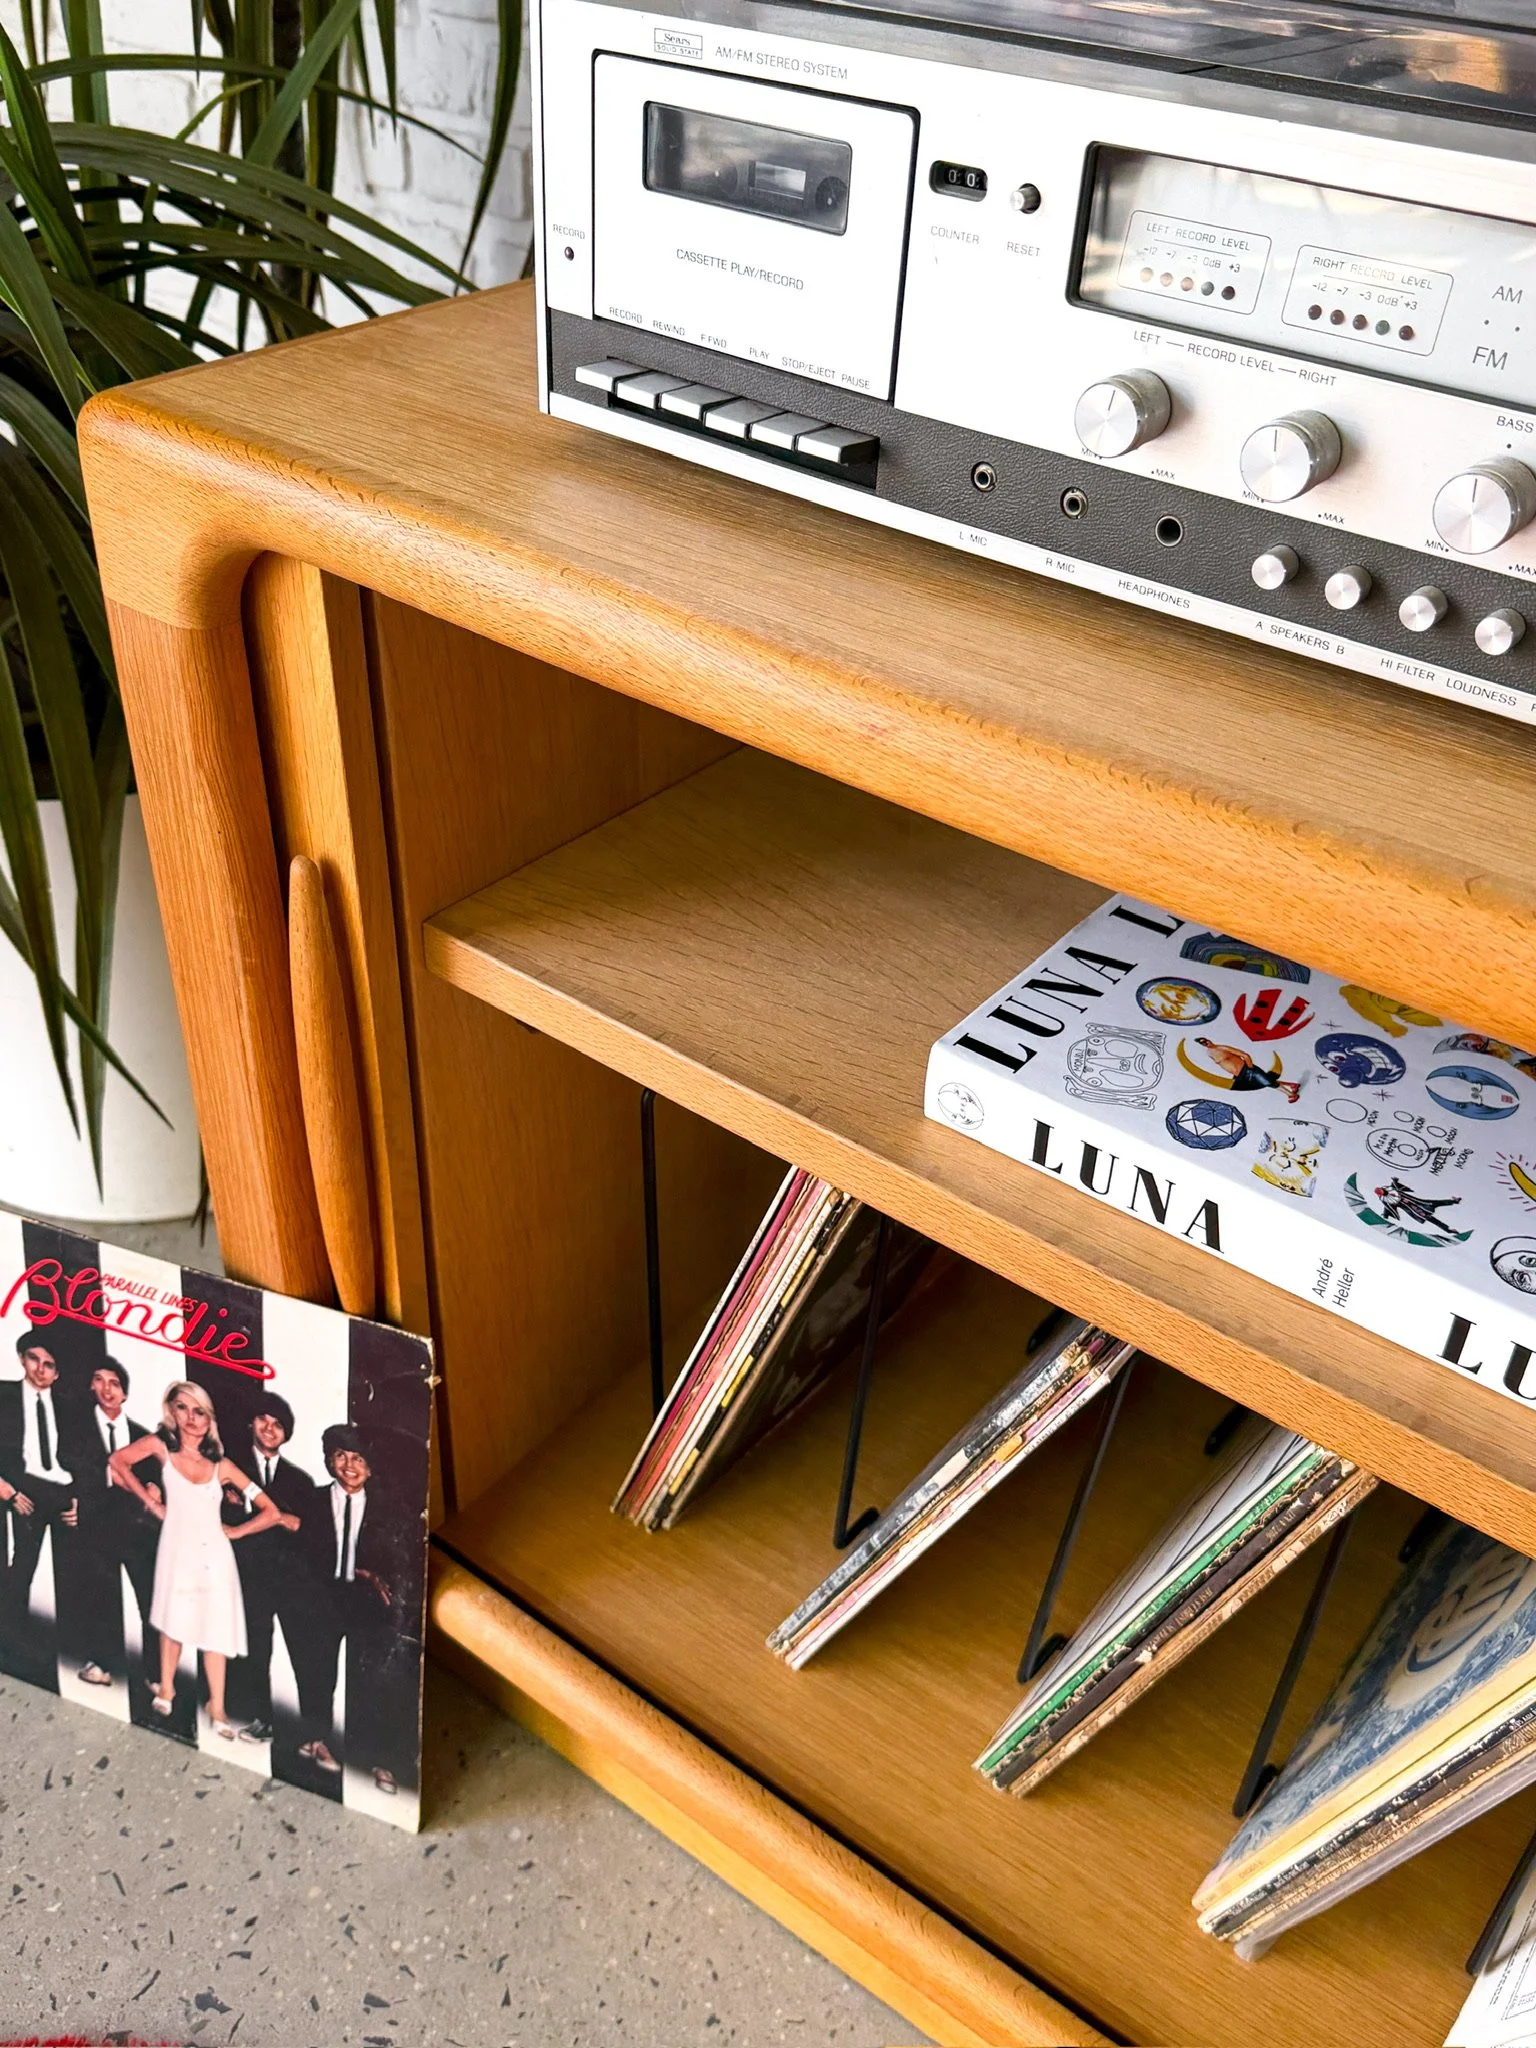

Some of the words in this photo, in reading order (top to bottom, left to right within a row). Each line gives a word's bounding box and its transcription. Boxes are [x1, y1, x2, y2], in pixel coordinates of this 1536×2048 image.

[663, 33, 691, 46] Sears
[656, 44, 677, 54] SOLID
[679, 48, 700, 57] STATE
[715, 46, 753, 63] AM/FM
[756, 53, 800, 71] STEREO
[803, 61, 848, 79] SYSTEM
[552, 223, 586, 240] RECORD
[930, 225, 981, 245] COUNTER
[1146, 222, 1170, 235] LEFT
[1175, 228, 1217, 244] RECORD
[1221, 237, 1251, 252] LEVEL
[1006, 241, 1041, 257] RESET
[676, 248, 728, 272] CASSETTE
[730, 262, 804, 291] PLAY/RECORD
[1312, 256, 1345, 270] RIGHT
[1350, 263, 1396, 282] RECORD
[1400, 275, 1433, 290] LEVEL
[1491, 285, 1523, 304] AM
[609, 306, 642, 324] RECORD
[653, 319, 686, 336] REWIND
[749, 347, 770, 361] PLAY
[1133, 330, 1161, 346] LEFT
[1187, 343, 1237, 364] RECORD
[1240, 355, 1275, 374] LEVEL
[1298, 368, 1338, 388] RIGHT
[1472, 346, 1508, 370] FM
[781, 356, 836, 380] STOP/EJECT
[841, 373, 871, 390] PAUSE
[1496, 415, 1535, 434] BASS
[1155, 468, 1176, 481] MAX
[1322, 512, 1345, 525] MAX
[958, 531, 965, 541] L
[970, 533, 988, 547] MIC
[1424, 538, 1445, 552] MIN
[1045, 556, 1053, 567] R
[1056, 560, 1076, 575] MIC
[1118, 579, 1191, 609] HEADPHONES
[1255, 620, 1263, 631] A
[1270, 624, 1331, 651] SPEAKERS
[1336, 645, 1345, 655] B
[1380, 657, 1393, 669] HI
[1396, 662, 1436, 682] FILTER
[1446, 677, 1518, 707] LOUDNESS
[953, 946, 1138, 1074] LUNA
[1367, 1110, 1379, 1127] MOON
[1412, 1115, 1426, 1134] MOON
[1445, 1126, 1458, 1144] MOON
[1028, 1118, 1224, 1254] LUNA
[1311, 1257, 1334, 1298] André
[100, 1273, 158, 1301] PARALLEL
[160, 1291, 198, 1312] LINES
[1332, 1267, 1355, 1308] Heller
[0, 1258, 275, 1380] Blondie
